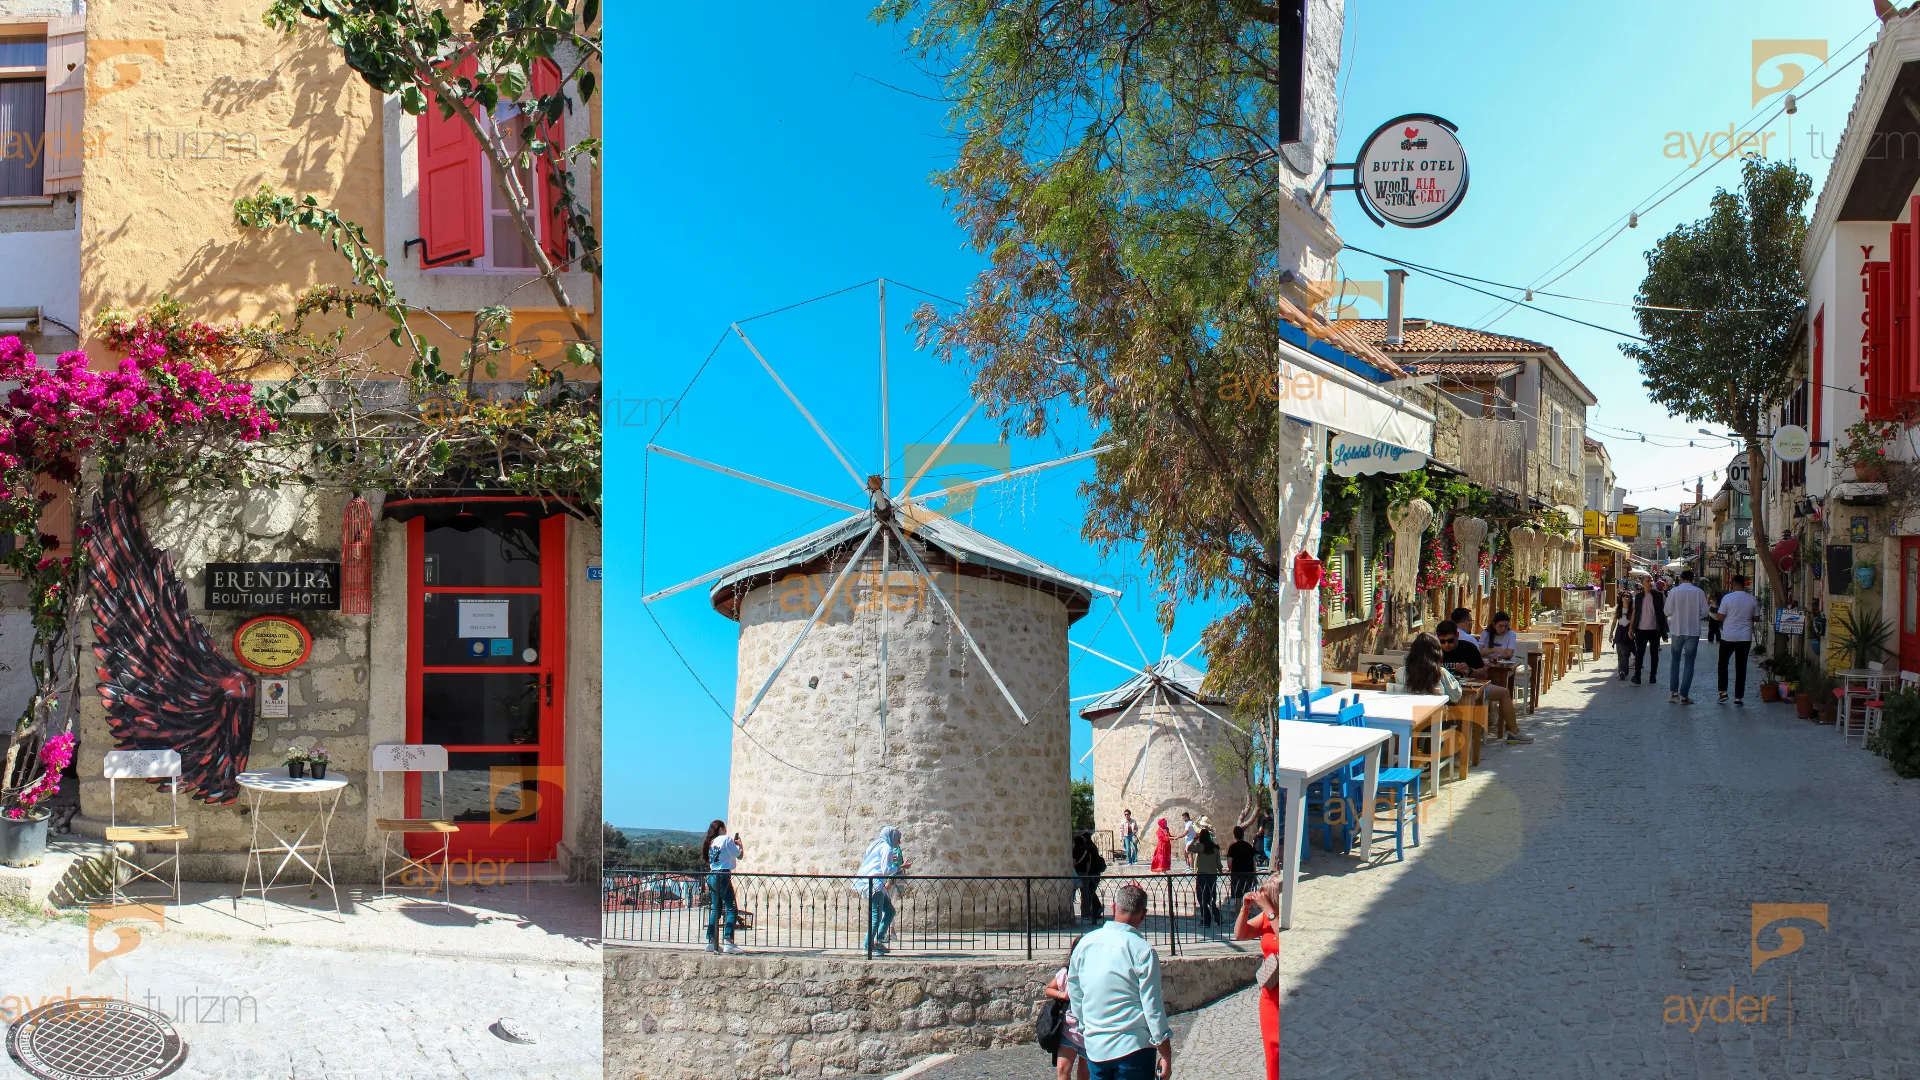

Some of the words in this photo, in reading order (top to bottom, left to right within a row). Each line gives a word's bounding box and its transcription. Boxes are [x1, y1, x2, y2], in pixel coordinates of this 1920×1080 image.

[1372, 159, 1415, 172] BUTİK
[1420, 160, 1455, 171] OTEL
[1374, 177, 1409, 199] WOOD
[1415, 177, 1436, 190] ALA
[1385, 189, 1417, 206] STOCK
[213, 568, 332, 593] ERENDİRA
[212, 592, 284, 604] BOUTIQUE
[290, 592, 334, 604] HOTEL
